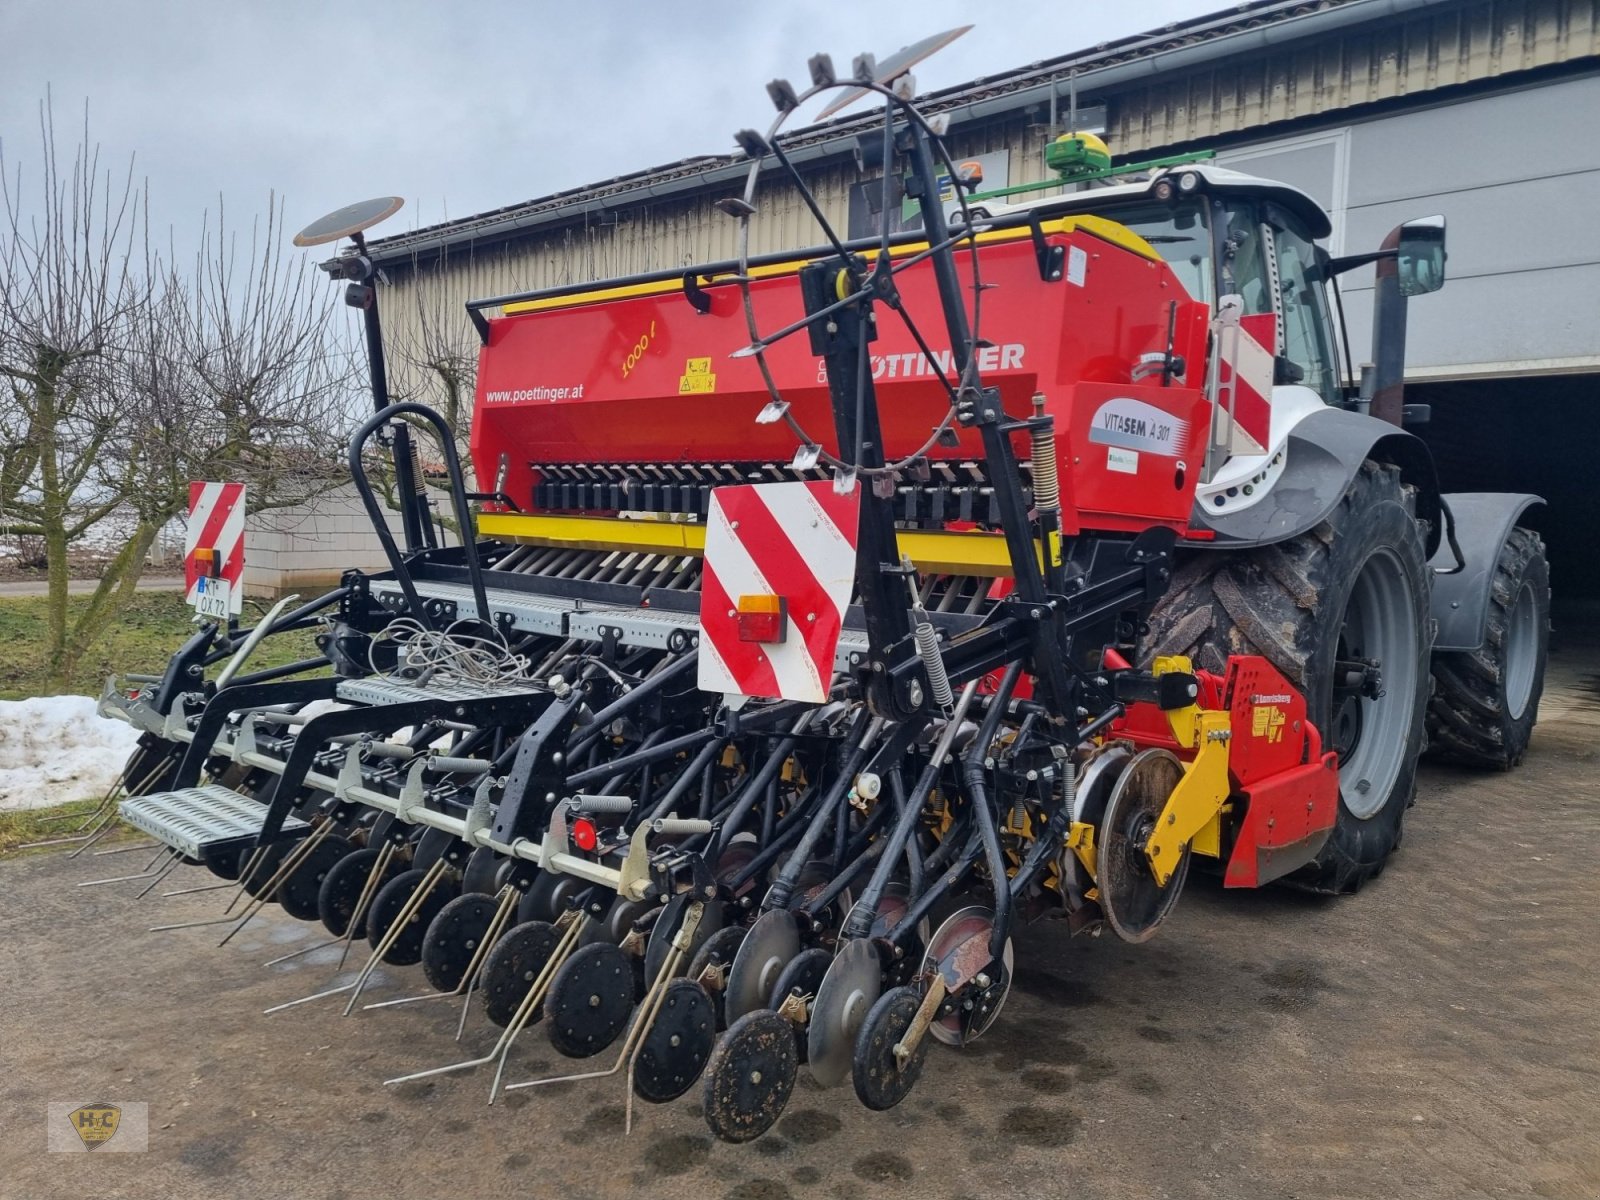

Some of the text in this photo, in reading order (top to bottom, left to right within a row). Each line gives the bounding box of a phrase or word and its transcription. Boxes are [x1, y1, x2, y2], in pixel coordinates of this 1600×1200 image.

[621, 334, 649, 378] 1000
[486, 384, 584, 404] www.poettinger.at
[1104, 412, 1147, 437] VITASEM
[1156, 424, 1171, 441] 301
[215, 599, 225, 617] 72
